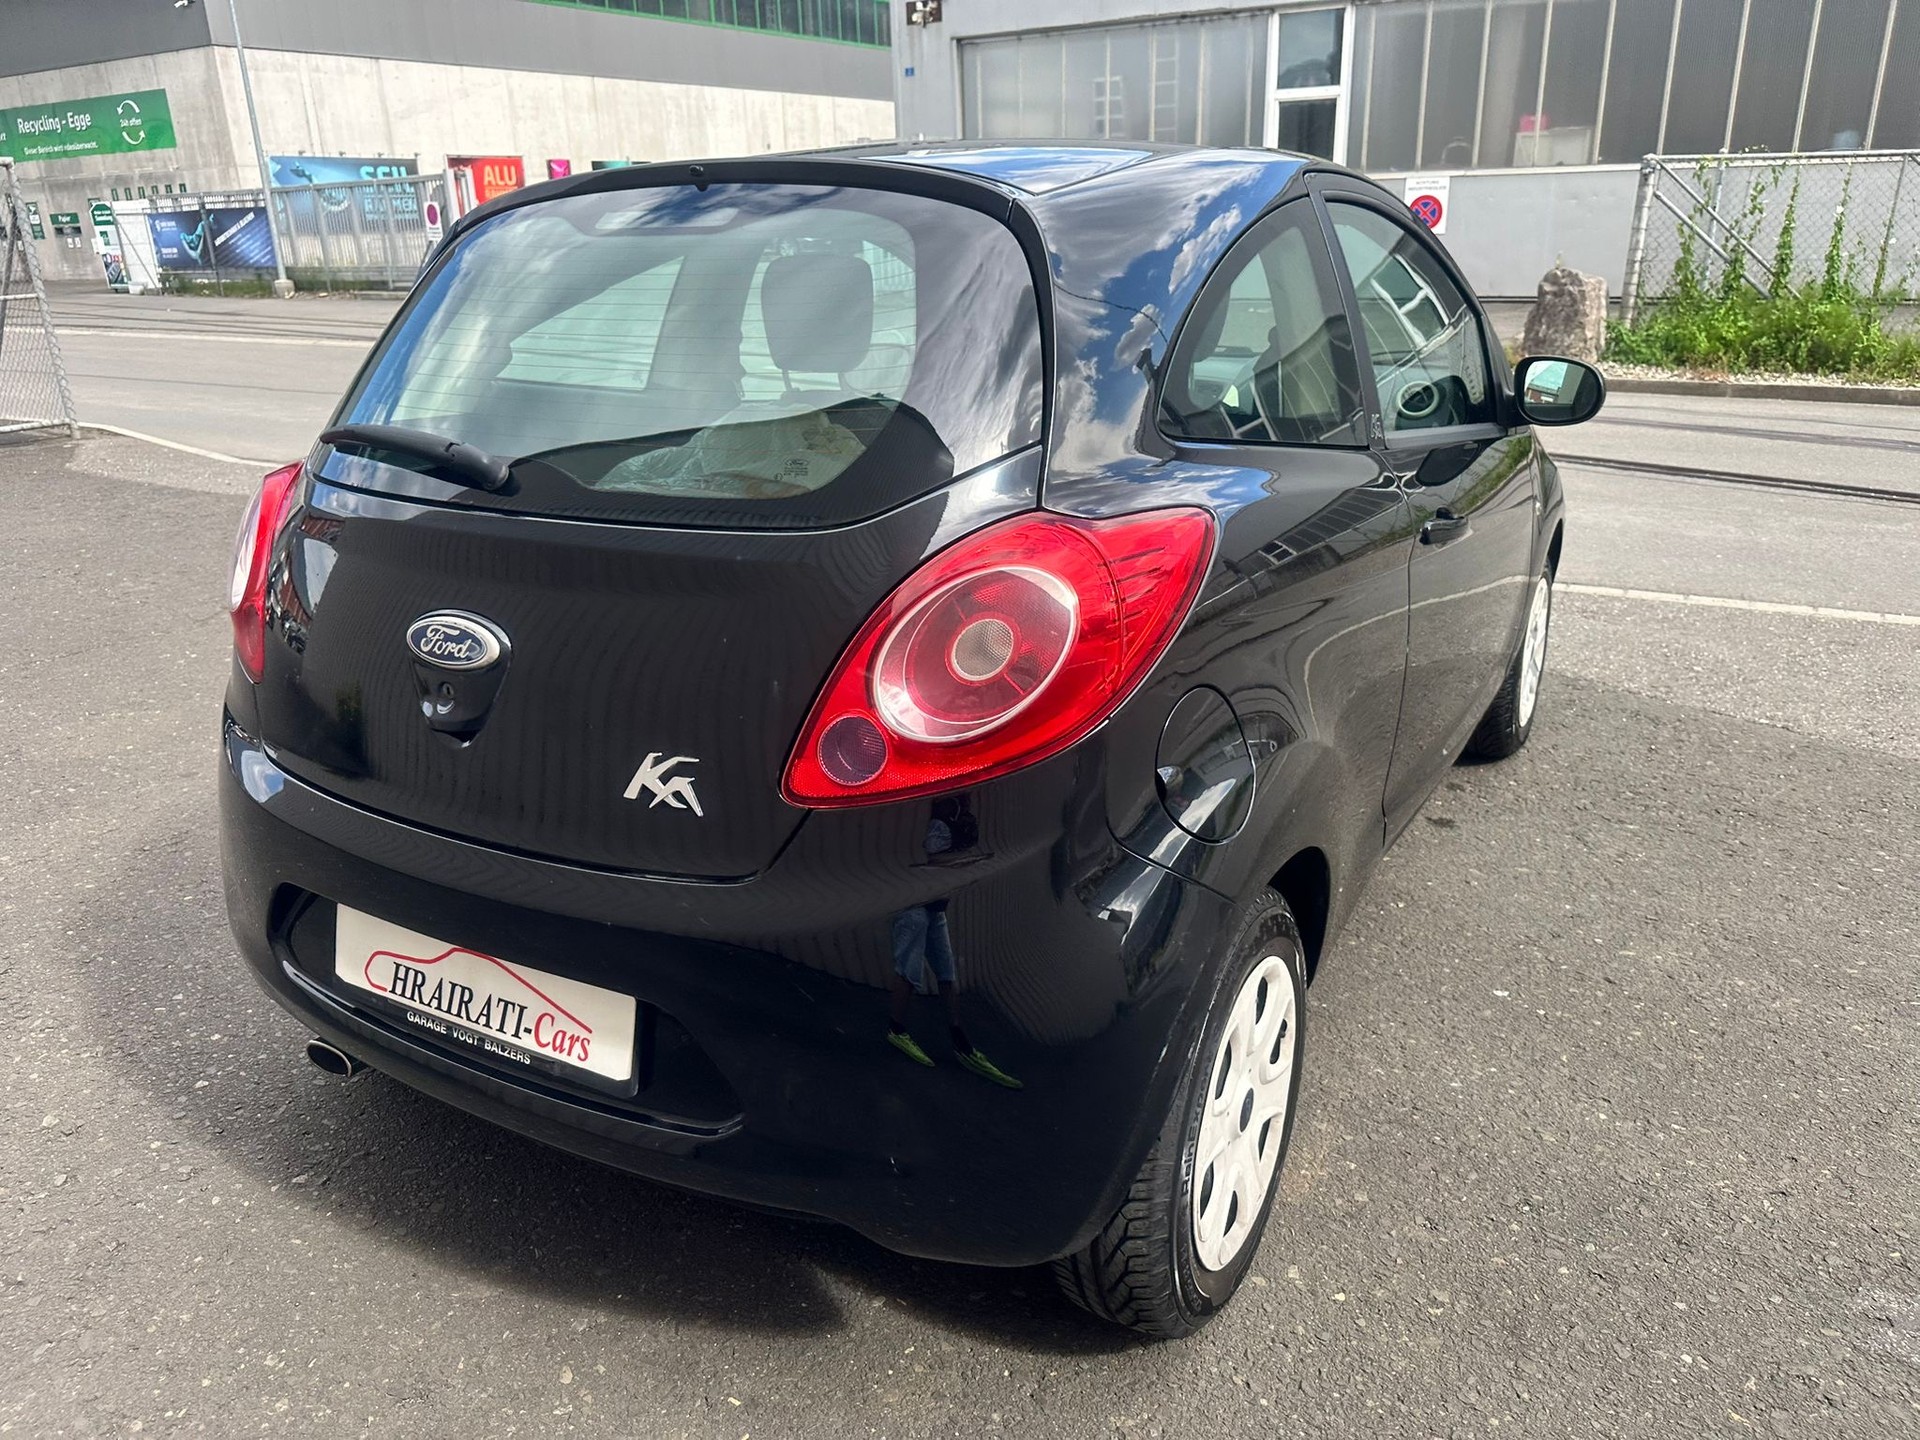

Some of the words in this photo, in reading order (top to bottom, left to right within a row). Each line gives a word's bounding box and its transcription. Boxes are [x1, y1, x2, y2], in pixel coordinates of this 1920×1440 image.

[17, 114, 61, 135] Recycling
[67, 112, 92, 131] Egge
[484, 165, 517, 186] ALU
[420, 624, 473, 660] Ford
[388, 961, 592, 1062] HRAIRATI-Cars
[407, 1011, 447, 1035] GARAGE
[452, 1027, 480, 1047] VOGT
[484, 1039, 531, 1065] BALZERS
